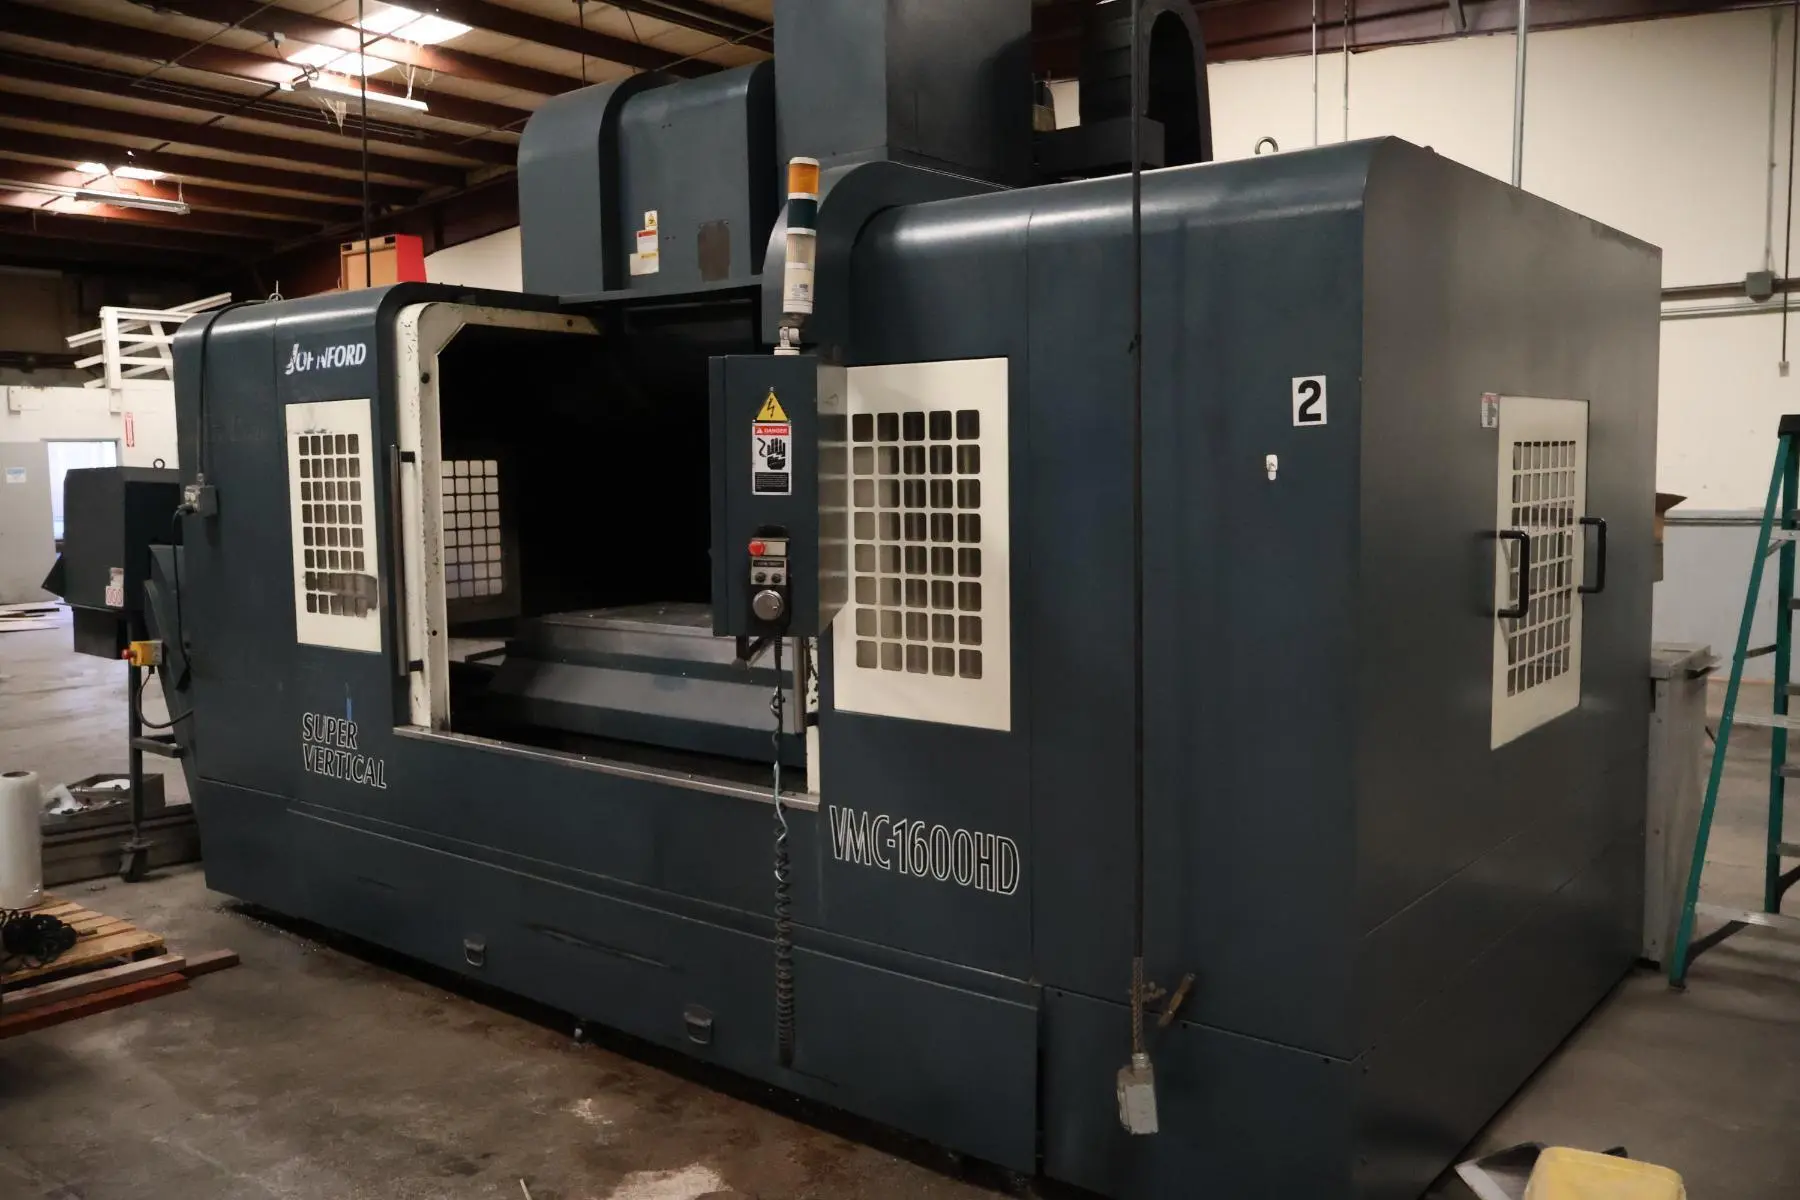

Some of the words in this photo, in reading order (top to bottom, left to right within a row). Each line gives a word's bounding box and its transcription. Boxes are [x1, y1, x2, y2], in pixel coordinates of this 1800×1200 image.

[1298, 380, 1321, 422] 2
[303, 712, 358, 750] SUPER
[303, 743, 387, 789] VERTICAL
[829, 805, 1020, 895] VMC-1600HD
